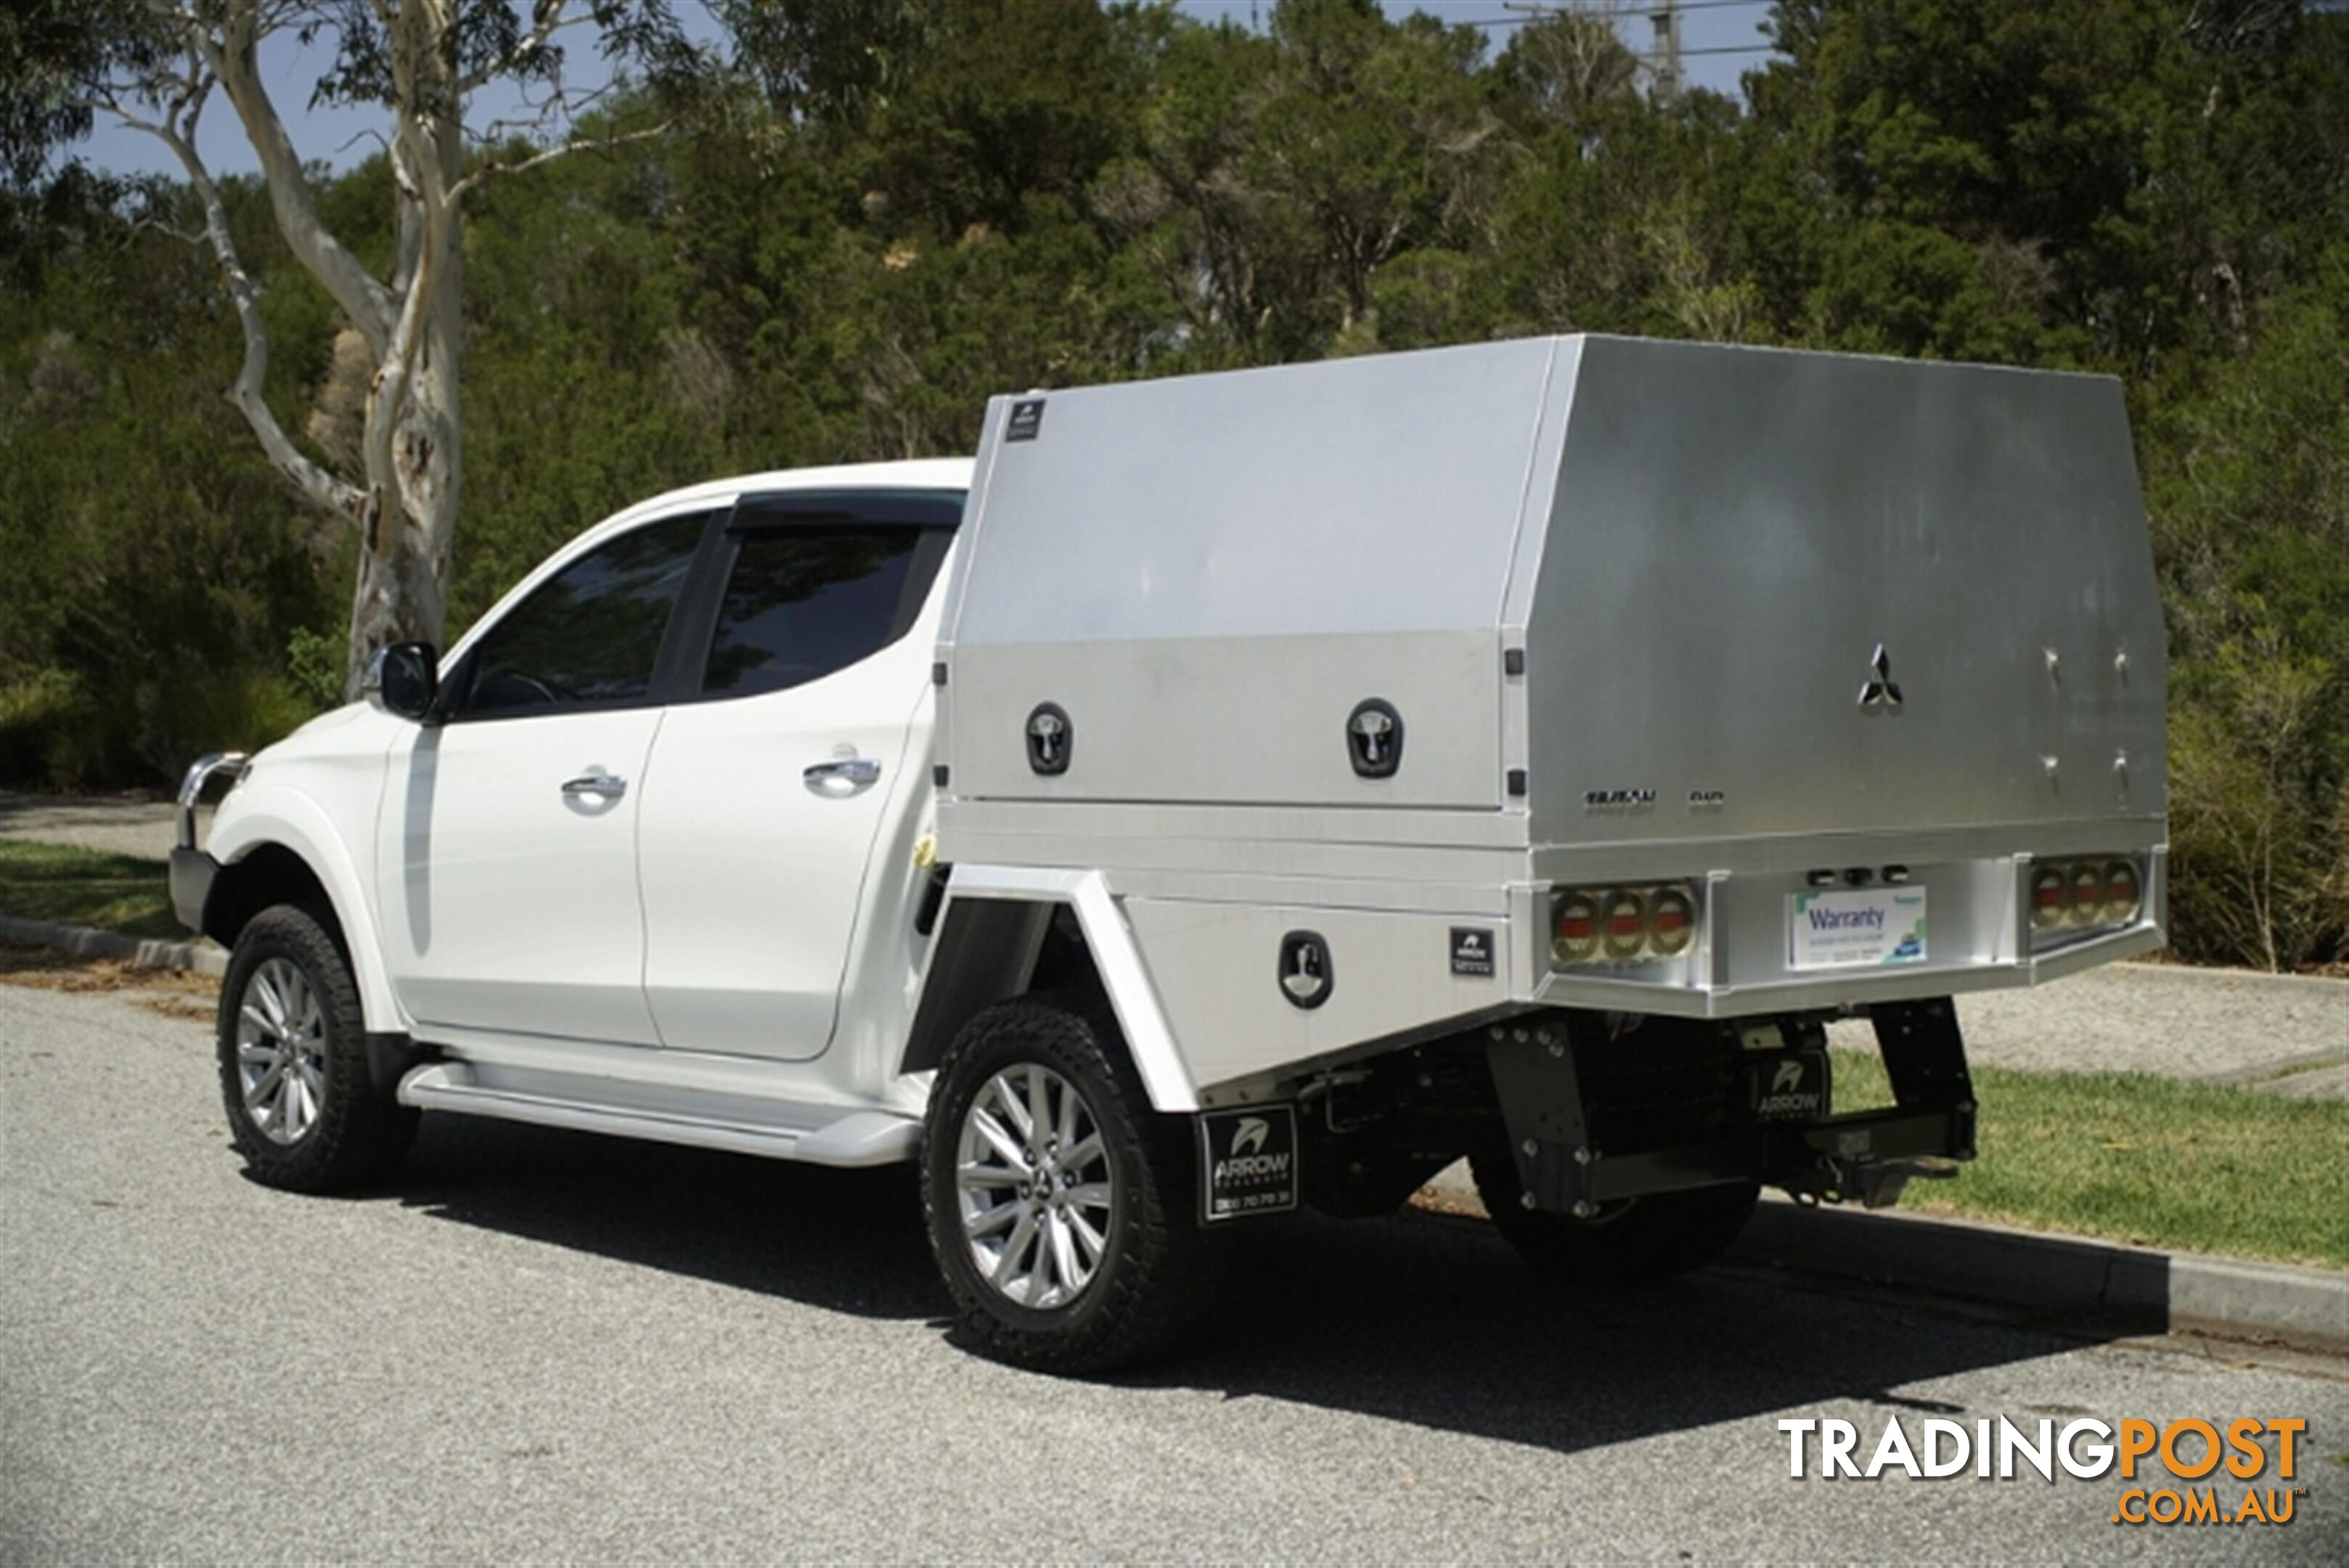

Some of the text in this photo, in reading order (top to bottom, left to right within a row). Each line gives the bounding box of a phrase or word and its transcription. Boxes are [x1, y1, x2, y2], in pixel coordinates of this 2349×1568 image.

[1809, 907, 1885, 930] Warranty
[1758, 1093, 1821, 1114] ARROW
[1214, 1153, 1289, 1179] ARROW
